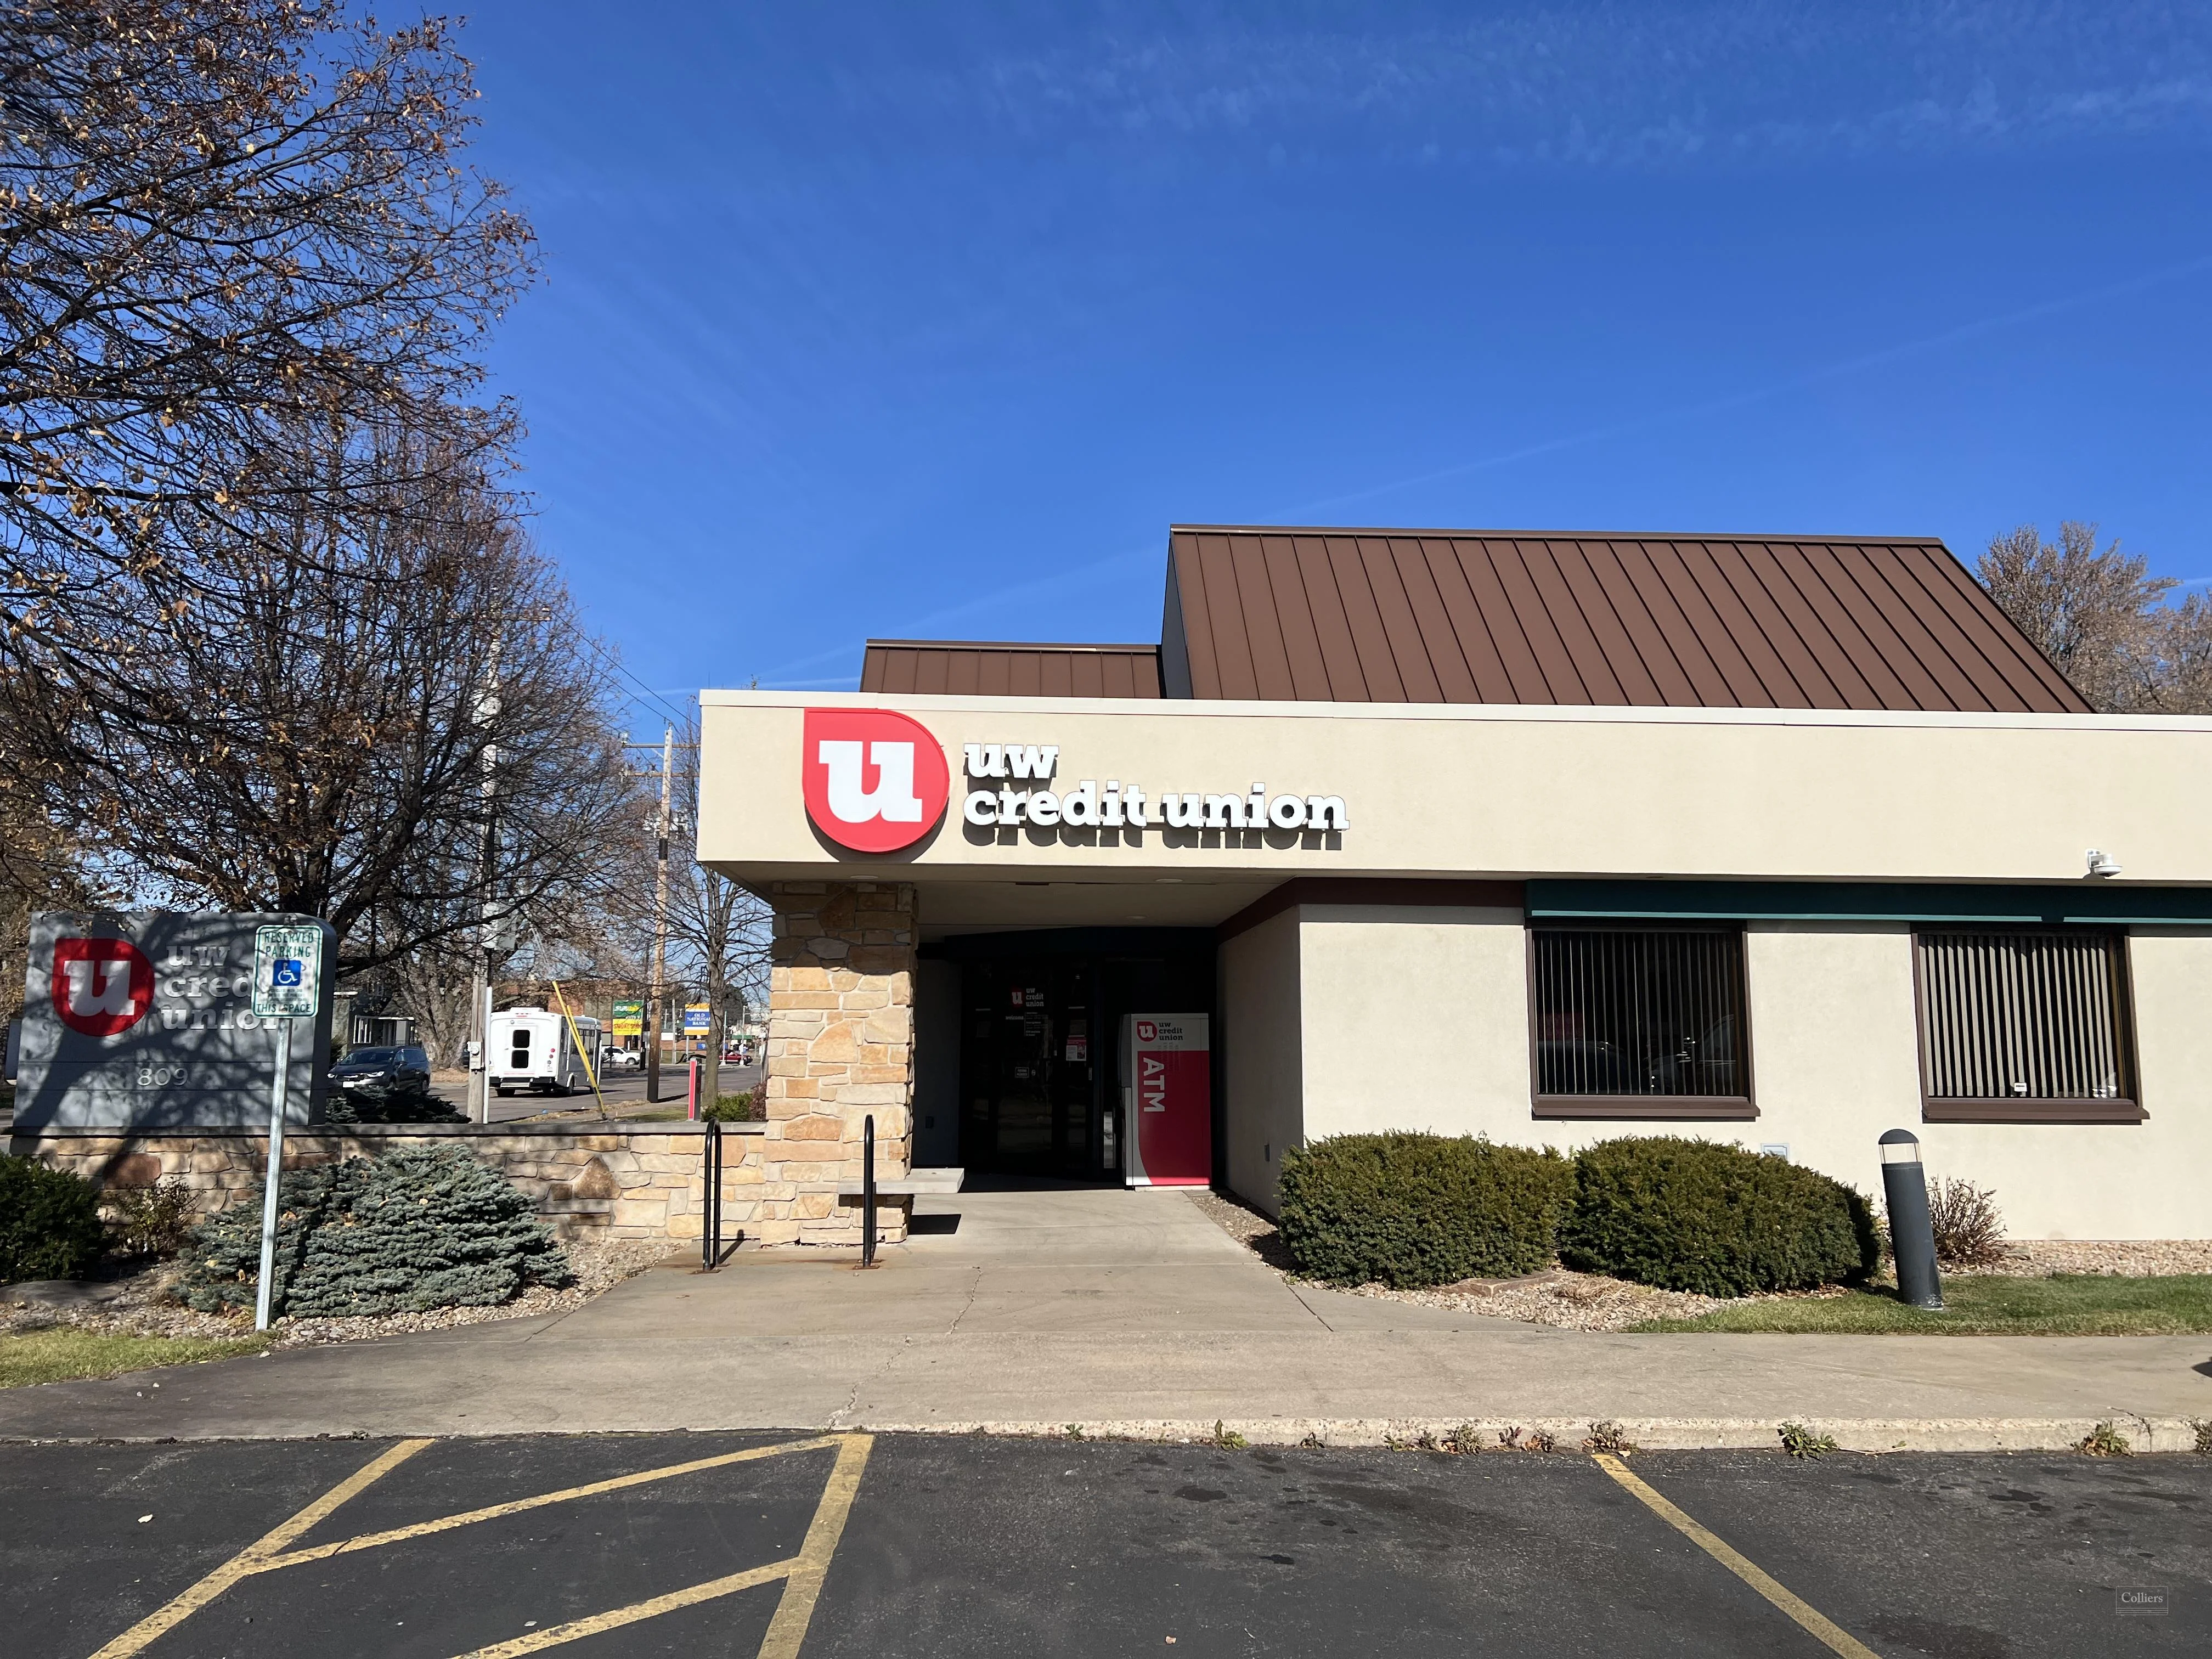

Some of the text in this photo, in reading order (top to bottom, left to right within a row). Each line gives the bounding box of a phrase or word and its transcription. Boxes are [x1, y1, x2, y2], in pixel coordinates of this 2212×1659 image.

[963, 742, 1059, 779] uw
[963, 780, 1350, 831] credit union
[264, 932, 314, 943] RESERVED
[166, 945, 230, 967] uw
[265, 946, 311, 957] PARKING
[164, 970, 253, 998] cred
[256, 1003, 311, 1013] THIS SPACE
[136, 1068, 189, 1087] 809
[1143, 1057, 1165, 1112] ATM
